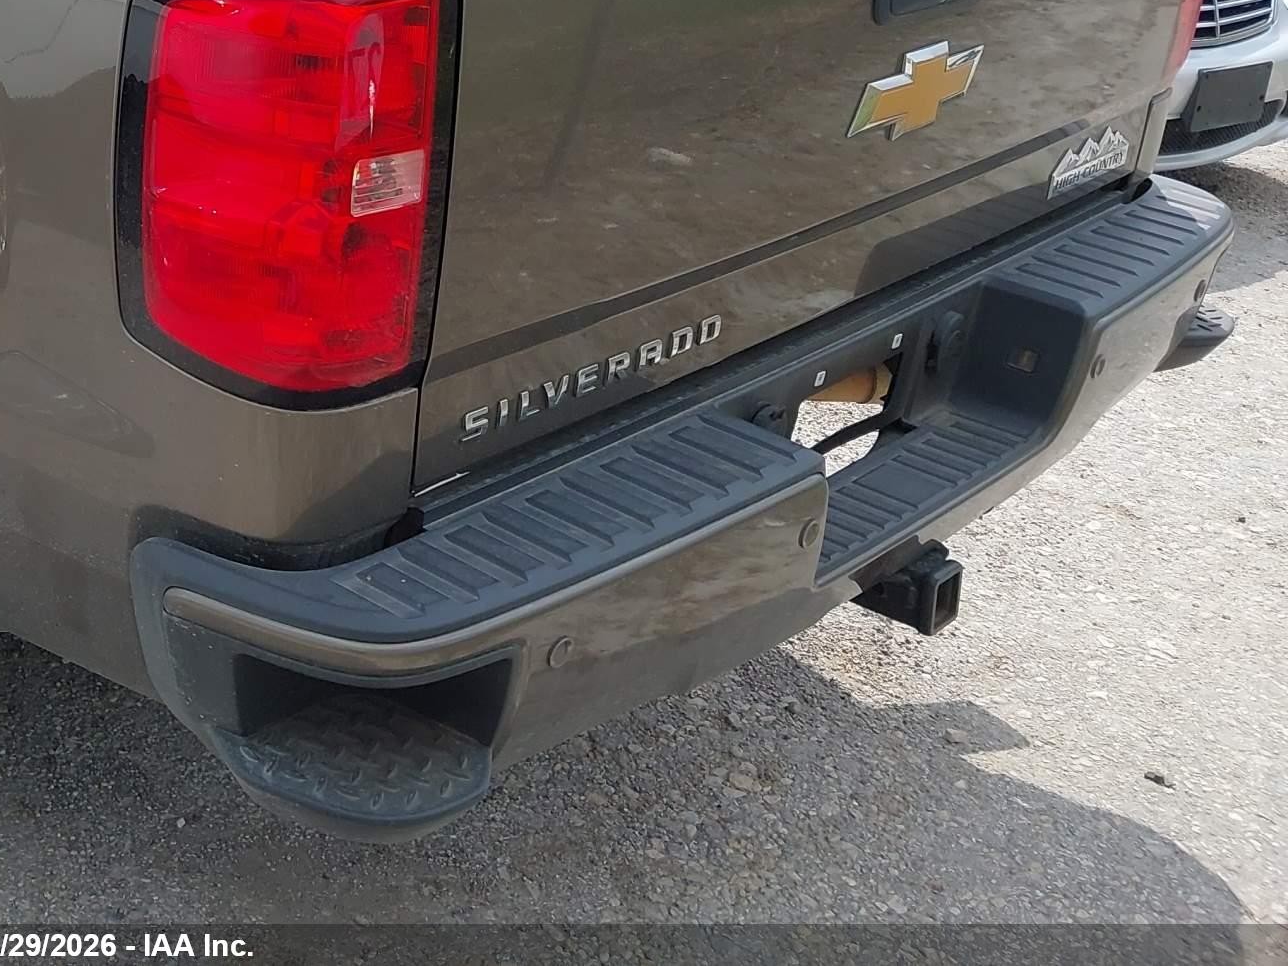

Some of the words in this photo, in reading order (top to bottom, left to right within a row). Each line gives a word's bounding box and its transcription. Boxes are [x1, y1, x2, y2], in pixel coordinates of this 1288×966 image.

[1056, 172, 1080, 189] HIGH
[1083, 153, 1123, 177] COUNTRY
[459, 314, 723, 443] SILVERADO
